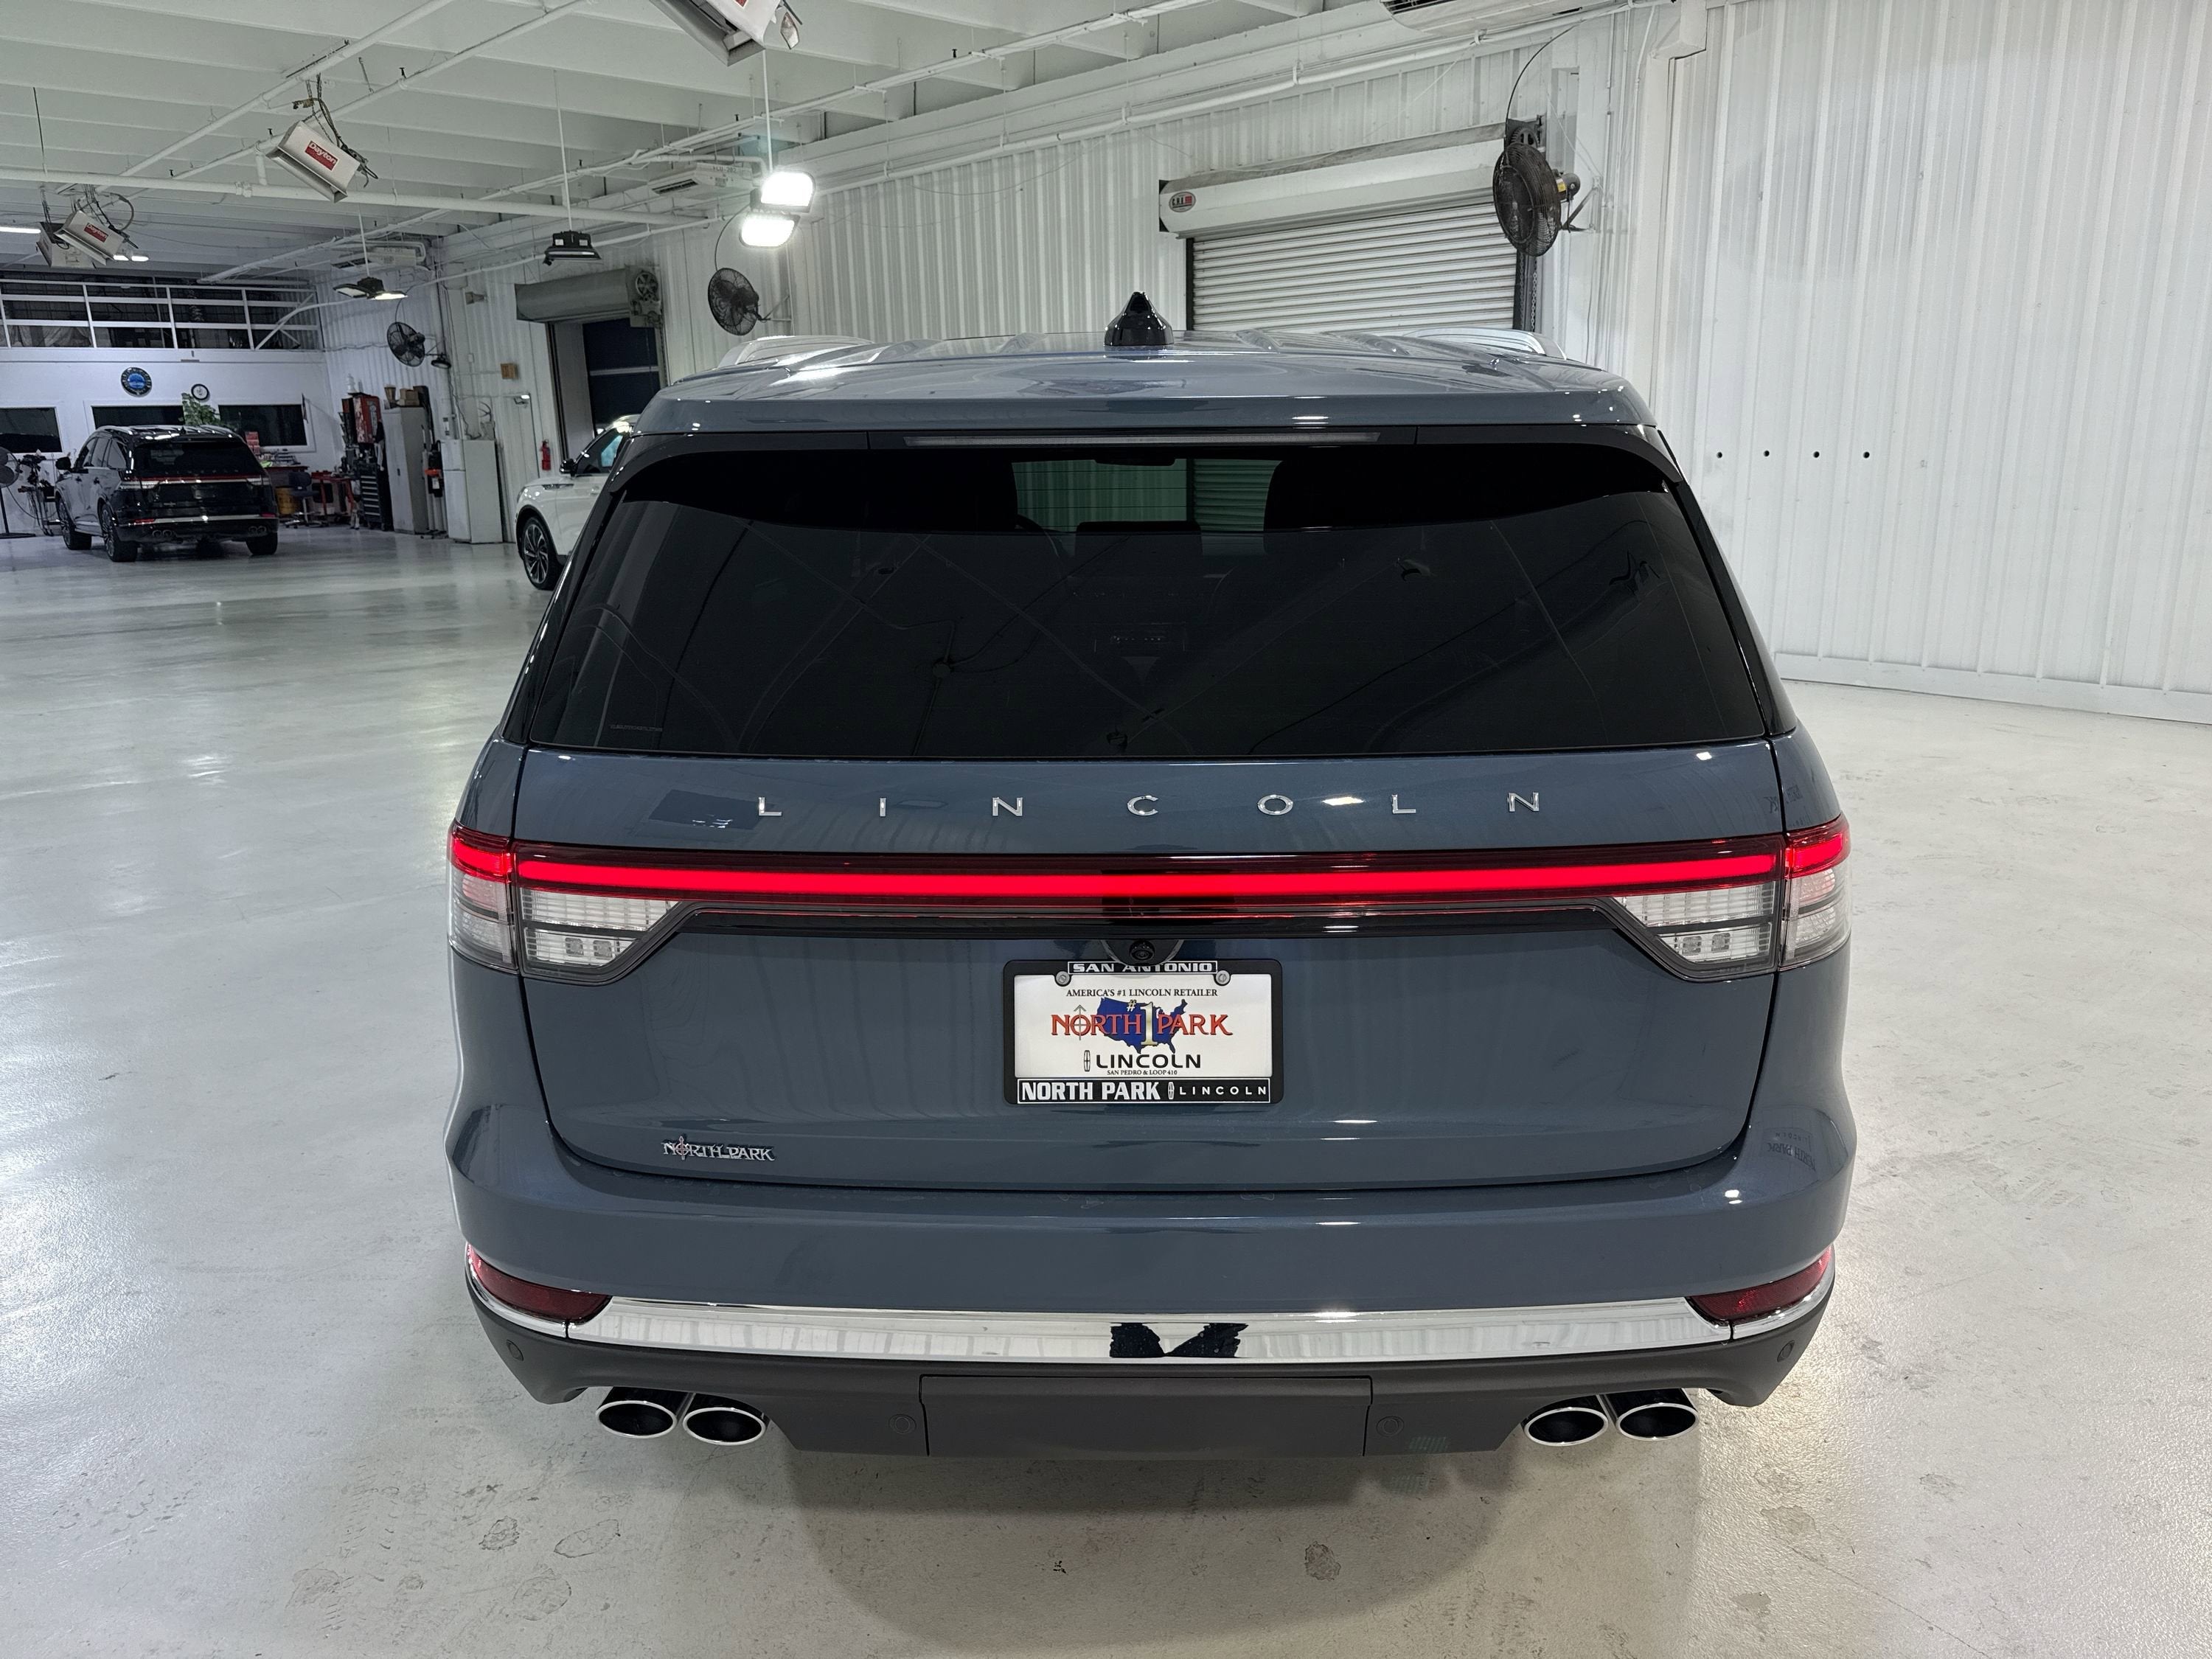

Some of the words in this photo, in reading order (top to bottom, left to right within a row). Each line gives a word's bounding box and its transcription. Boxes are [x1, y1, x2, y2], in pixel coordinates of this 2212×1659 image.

[310, 142, 336, 164] Dayton
[758, 792, 1540, 817] LINCOLN
[1073, 964, 1114, 973] SAN
[1066, 989, 1115, 997] AMERICA'S
[1129, 989, 1172, 997] LINCOLN
[1174, 989, 1217, 997] RETAILER
[1051, 1014, 1142, 1036] NORTH
[1157, 1014, 1233, 1036] PARK
[1096, 1054, 1201, 1068] LINCOLN
[1022, 1082, 1093, 1100] NORTH
[1102, 1082, 1161, 1100] PARK
[1180, 1085, 1267, 1096] LINCOLN
[662, 1142, 723, 1158] NORTH
[726, 1147, 775, 1161] PARK
